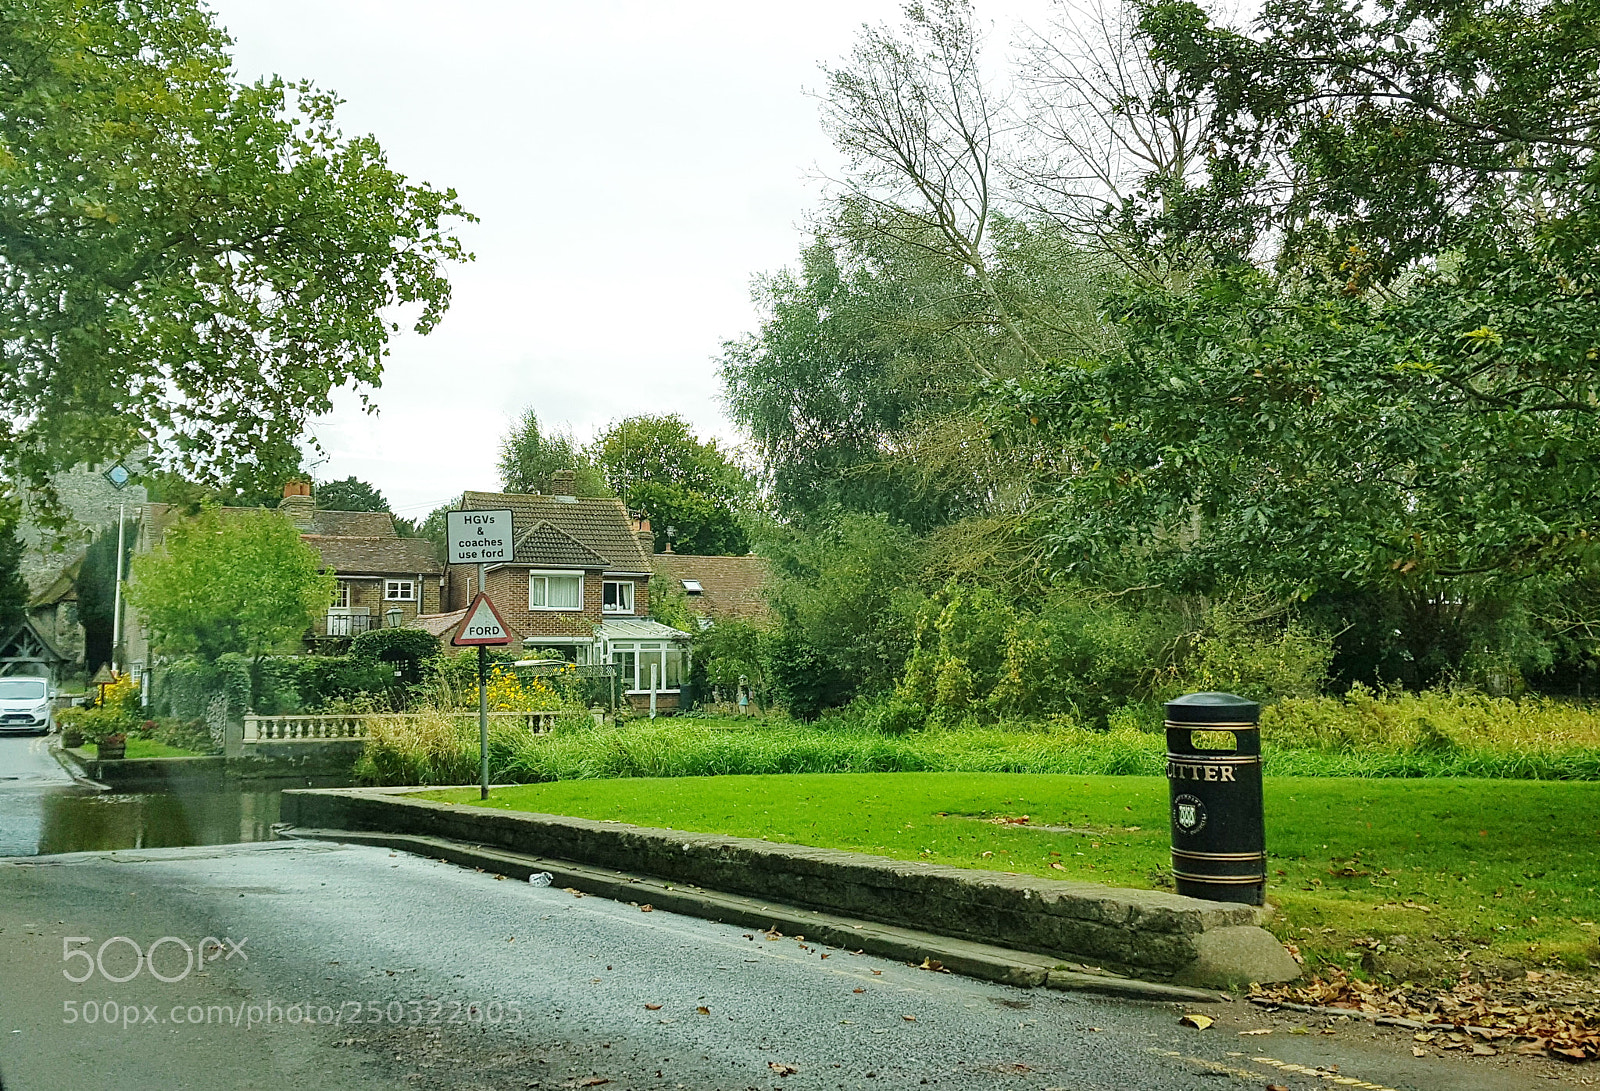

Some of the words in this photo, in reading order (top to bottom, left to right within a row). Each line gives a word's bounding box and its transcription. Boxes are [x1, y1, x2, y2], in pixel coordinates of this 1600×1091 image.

[464, 515, 495, 525] HGVs
[477, 527, 484, 535] &
[459, 538, 503, 548] coaches
[459, 551, 477, 559] use
[481, 549, 504, 558] ford
[470, 626, 500, 635] FORD
[1166, 762, 1236, 782] LITTER
